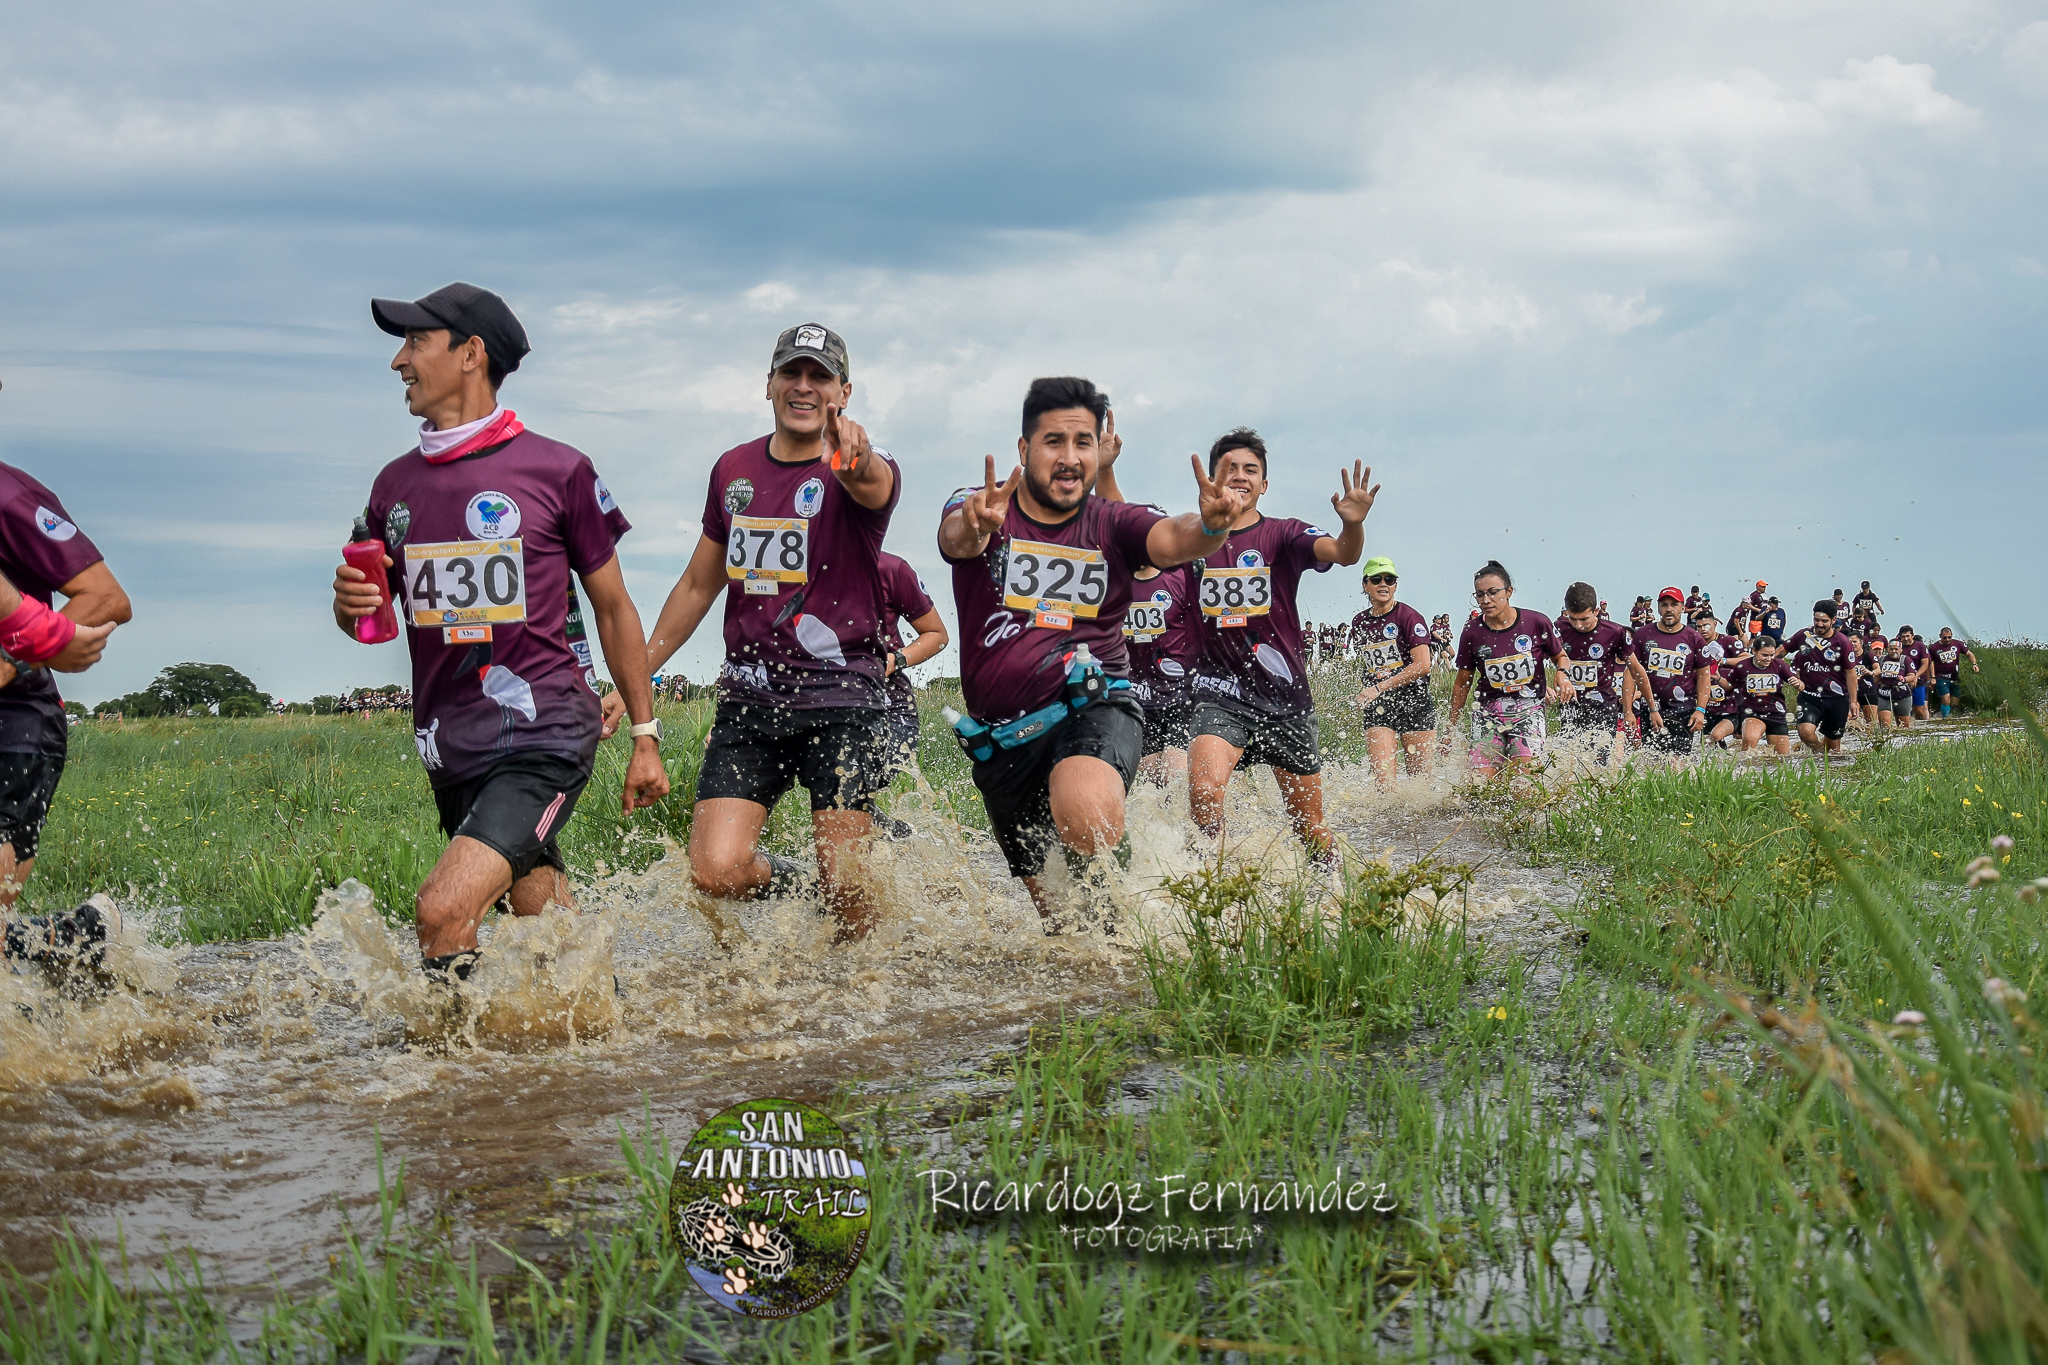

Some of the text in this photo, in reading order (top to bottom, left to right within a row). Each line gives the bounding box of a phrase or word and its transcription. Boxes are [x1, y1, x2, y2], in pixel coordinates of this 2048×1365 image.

[729, 527, 805, 571] 378
[1014, 543, 1081, 558] crc-system.com
[412, 554, 519, 610] 430
[1010, 553, 1106, 606] 325
[1202, 576, 1269, 608] 383
[1122, 607, 1163, 630] 403
[1650, 651, 1684, 670] 316
[1940, 651, 1956, 661] 326
[1487, 658, 1532, 682] 381
[1569, 665, 1597, 683] 05
[1882, 663, 1900, 671] 377
[1747, 677, 1776, 690] 314
